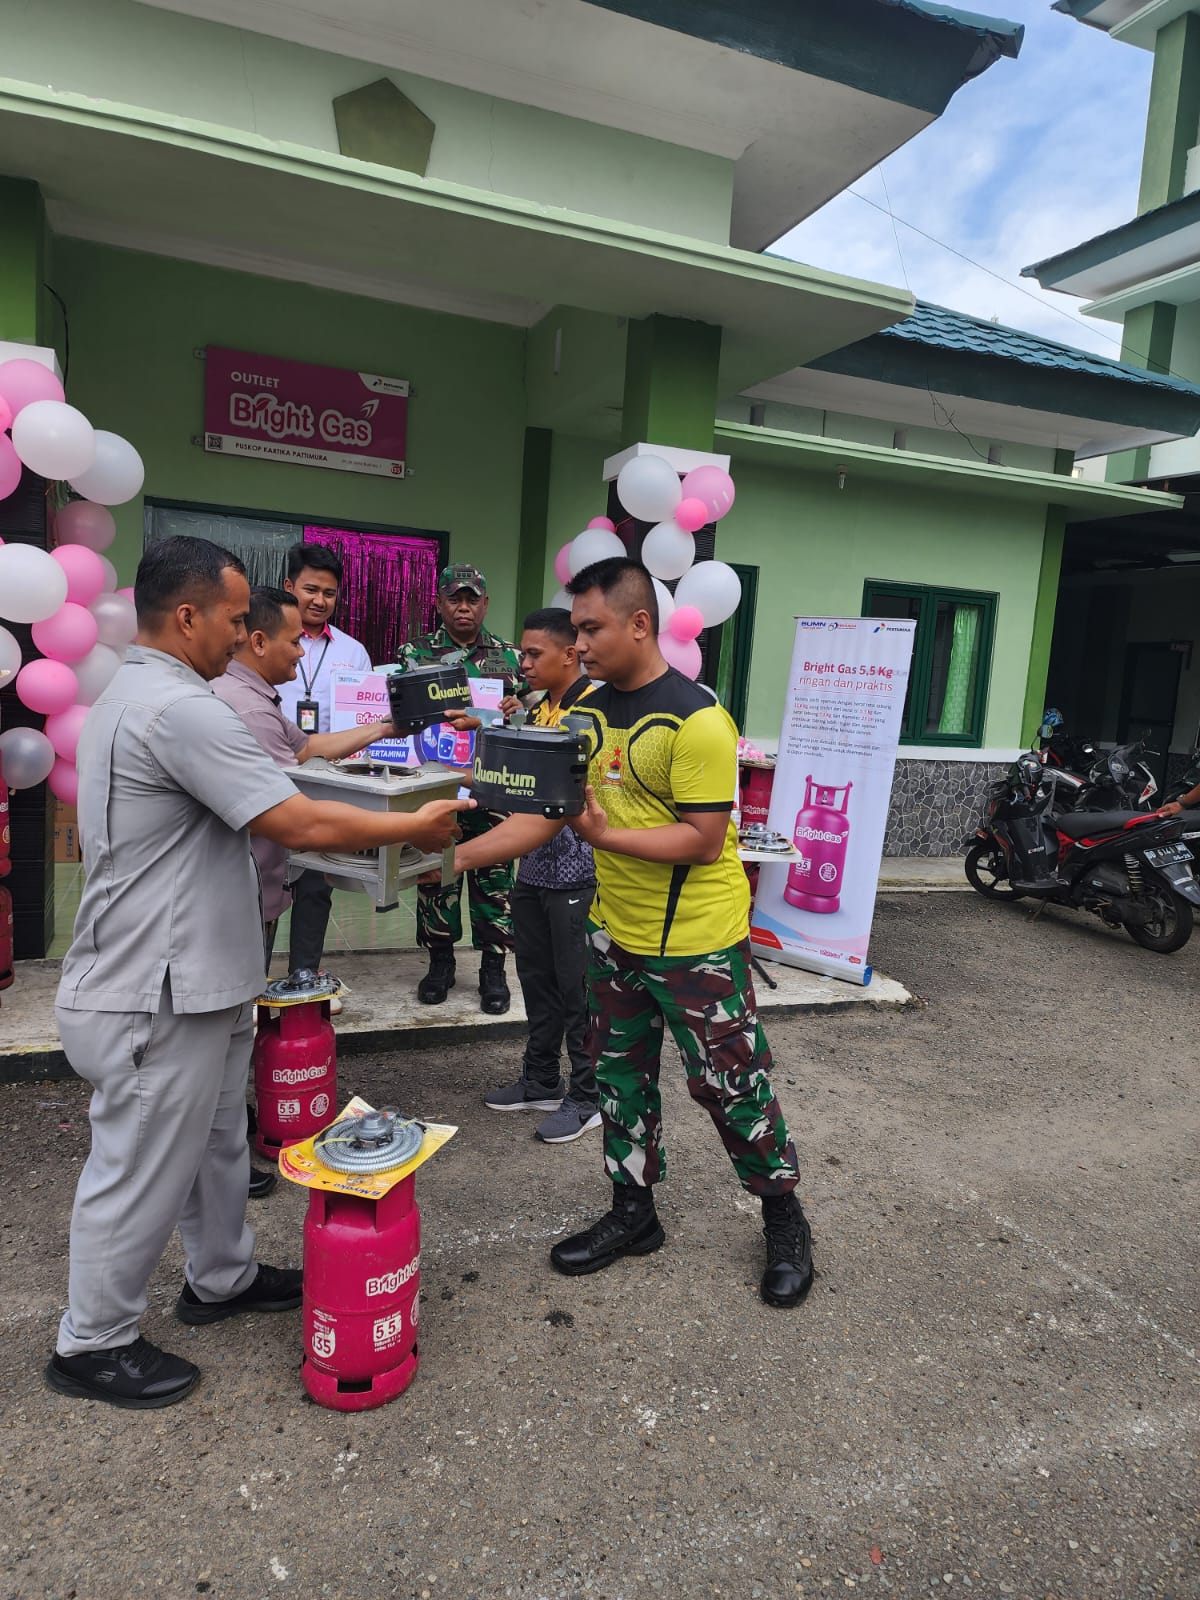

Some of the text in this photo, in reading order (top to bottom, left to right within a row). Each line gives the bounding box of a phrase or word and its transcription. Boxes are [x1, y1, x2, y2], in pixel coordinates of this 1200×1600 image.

[231, 371, 280, 389] OUTLET
[230, 393, 372, 447] Bright Gas
[235, 442, 328, 462] PUSKOP KARTIKA PATTIMURA
[804, 661, 835, 675] Bright
[838, 663, 857, 674] Gas
[878, 666, 894, 679] Kg
[799, 675, 893, 692] ringan dan praktis
[370, 750, 406, 759] ERTAMINA
[474, 756, 536, 789] Quantum
[505, 787, 535, 797] RESTO
[795, 826, 843, 844] Bright Gas
[273, 1065, 328, 1085] Bright Gas
[366, 1264, 410, 1297] Bright
